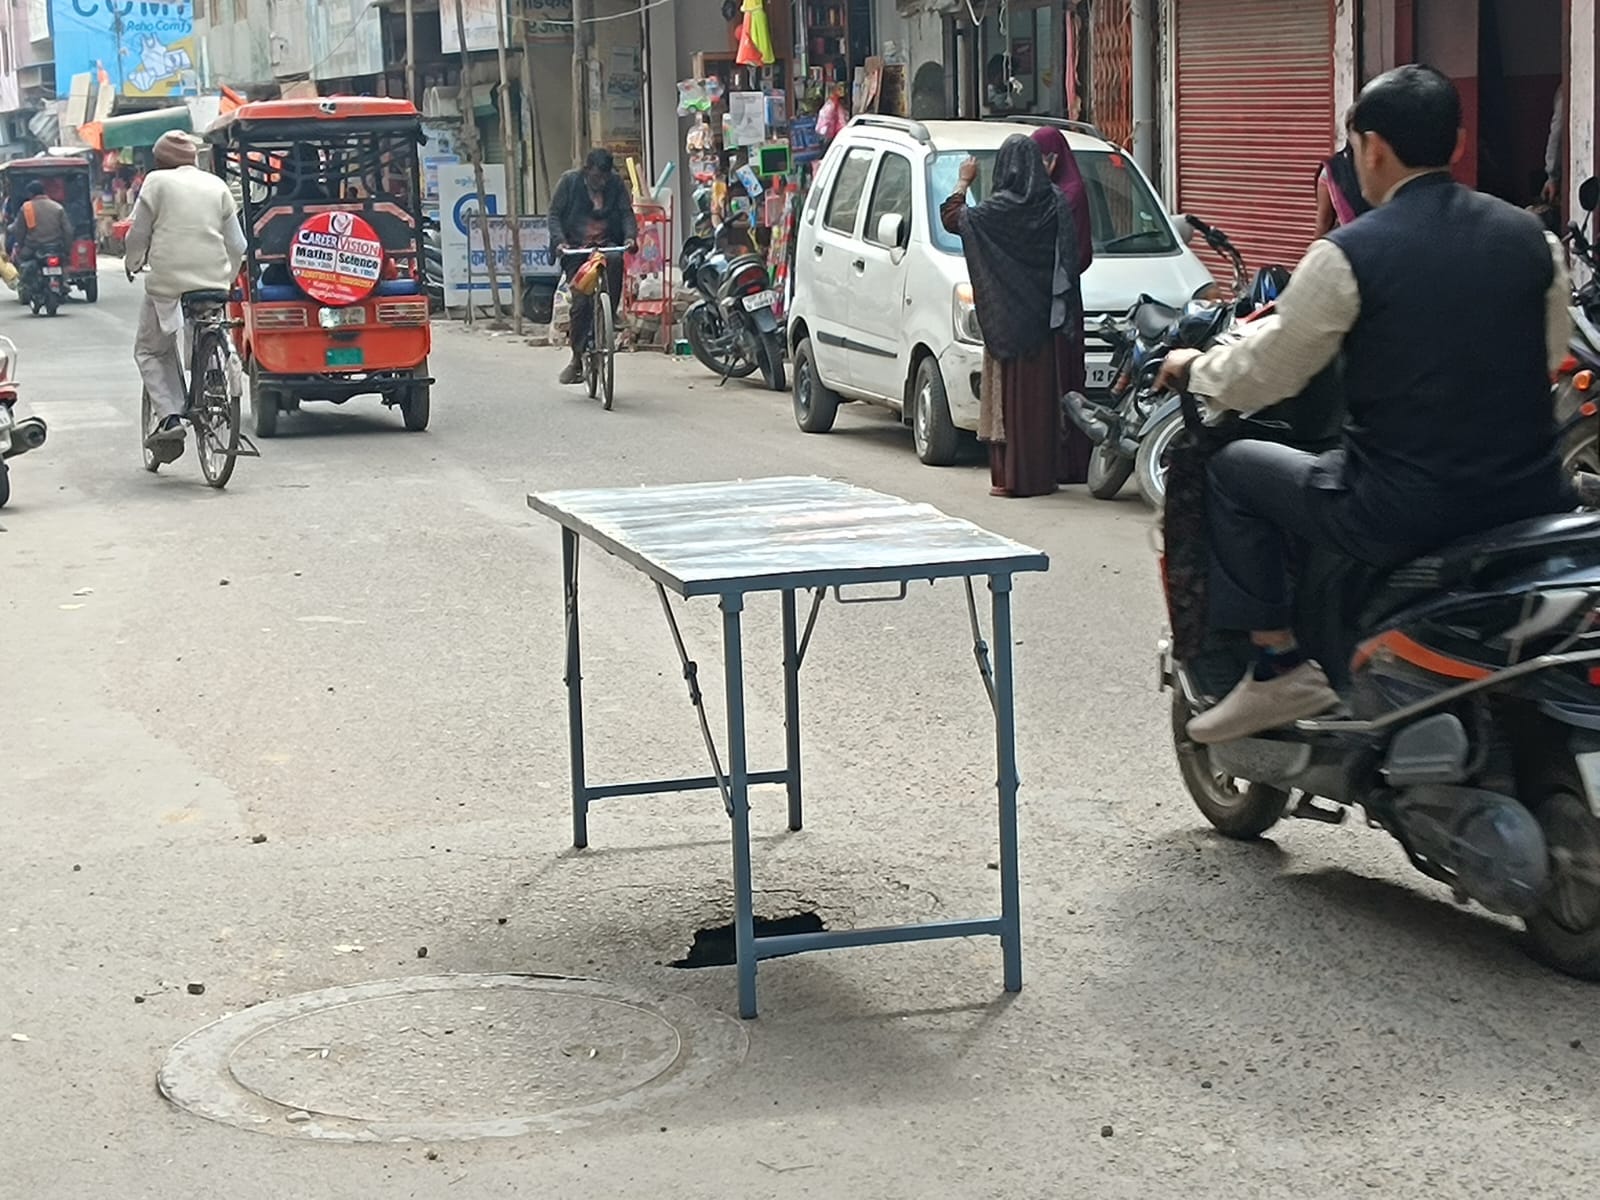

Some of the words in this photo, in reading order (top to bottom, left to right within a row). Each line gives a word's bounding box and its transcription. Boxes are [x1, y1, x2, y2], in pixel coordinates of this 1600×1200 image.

[295, 246, 333, 262] Maths
[339, 236, 379, 256] VISION
[338, 253, 379, 269] Science
[1092, 369, 1105, 382] 12
